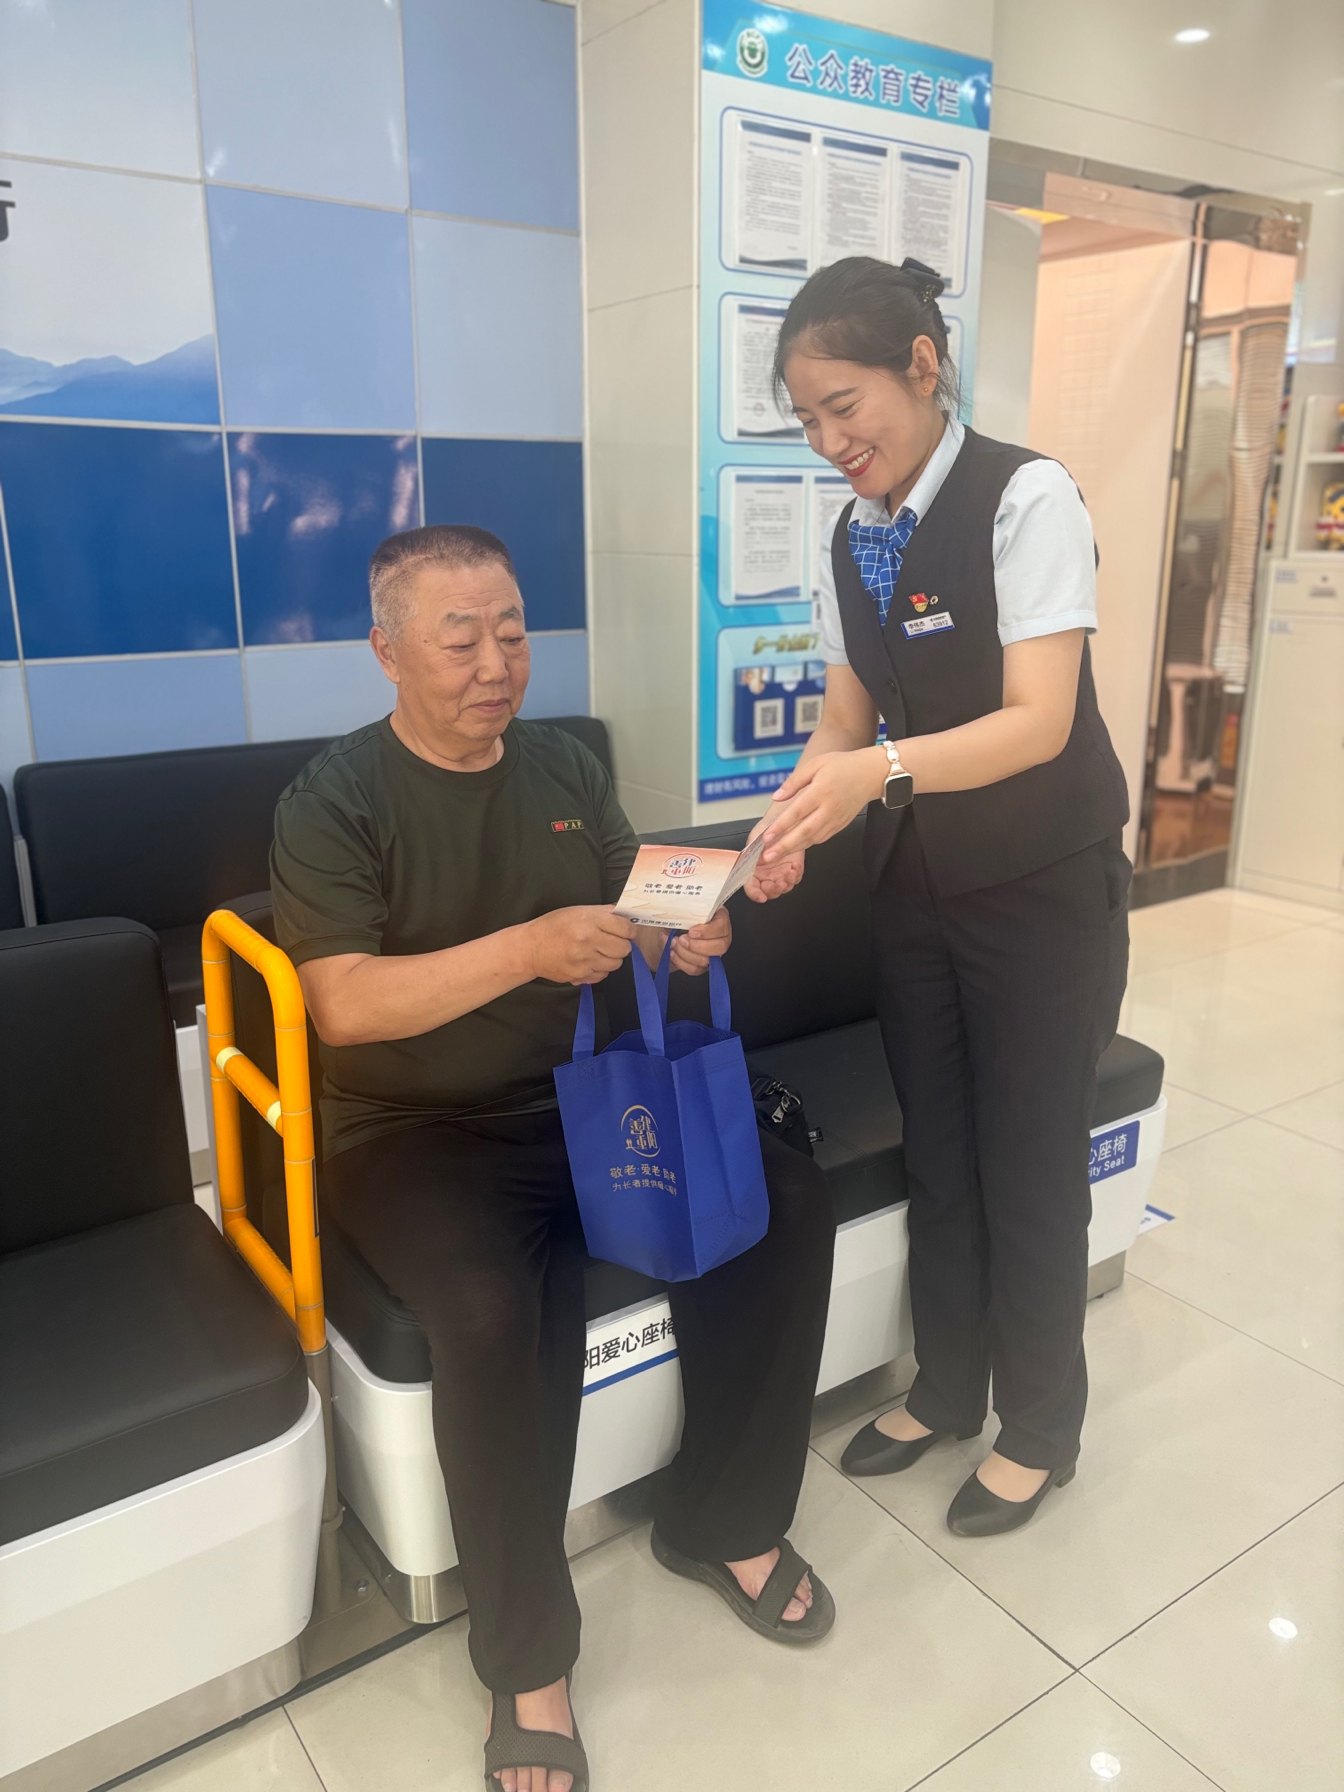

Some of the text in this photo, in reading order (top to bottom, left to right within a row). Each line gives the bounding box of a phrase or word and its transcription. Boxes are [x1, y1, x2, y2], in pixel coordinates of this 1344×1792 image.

[786, 44, 959, 116] 公众教育专栏
[1104, 1155, 1125, 1171] Seat
